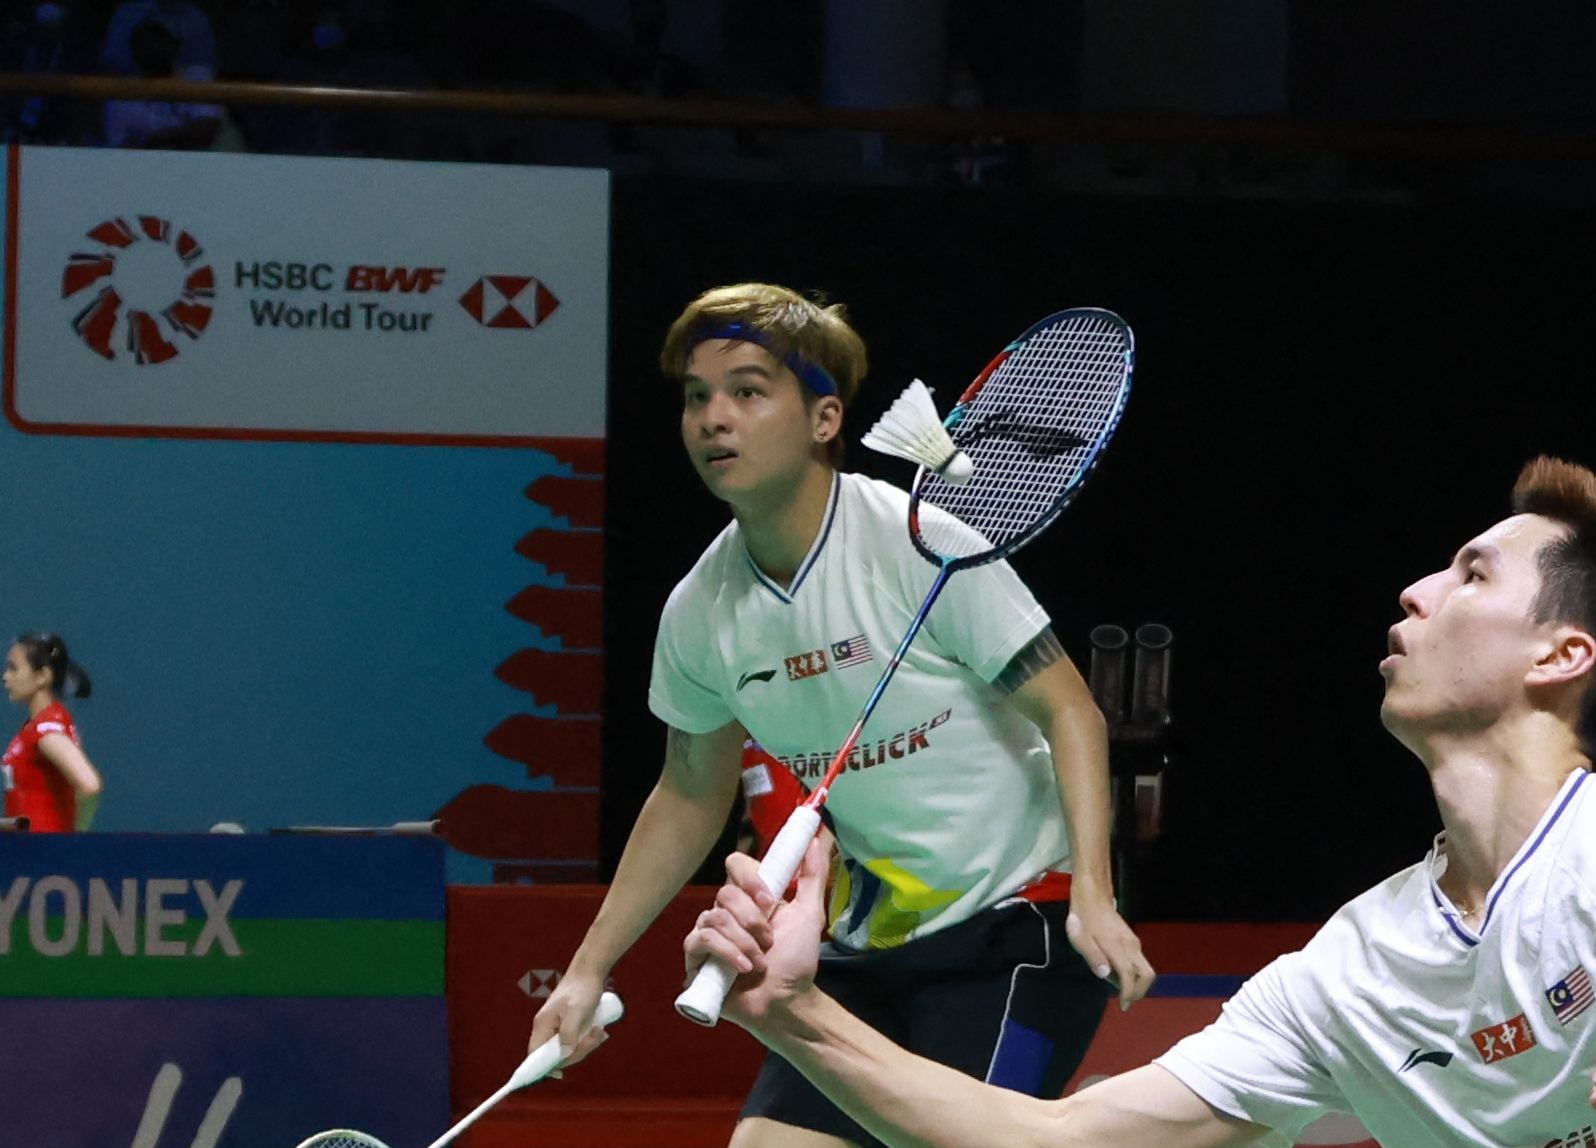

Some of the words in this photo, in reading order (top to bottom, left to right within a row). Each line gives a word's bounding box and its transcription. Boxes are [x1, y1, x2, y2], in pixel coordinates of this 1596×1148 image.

[235, 261, 334, 292] HSBC
[345, 264, 446, 294] BWF
[249, 299, 351, 330] World
[359, 302, 433, 332] Tour
[0, 875, 243, 957] YONEX
